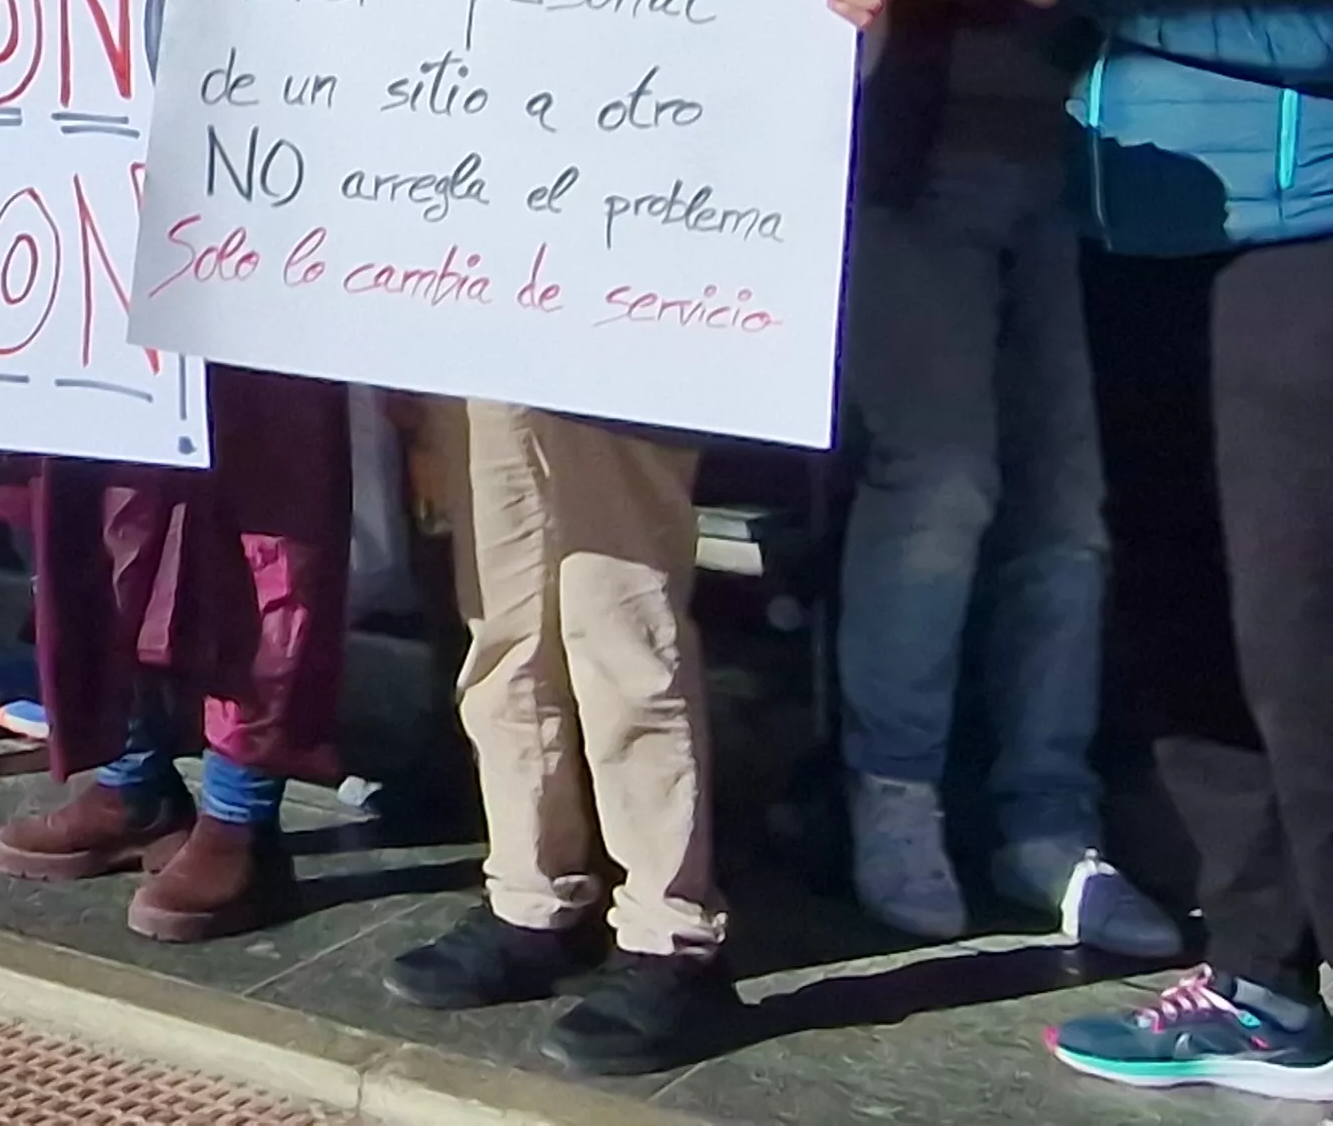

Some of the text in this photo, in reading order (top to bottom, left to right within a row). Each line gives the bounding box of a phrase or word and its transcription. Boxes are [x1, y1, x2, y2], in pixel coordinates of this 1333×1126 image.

[201, 46, 704, 134] de un sitio a otro
[203, 124, 785, 251] NO arregla el problema
[148, 215, 783, 335] Solo lo cambia de servicio
